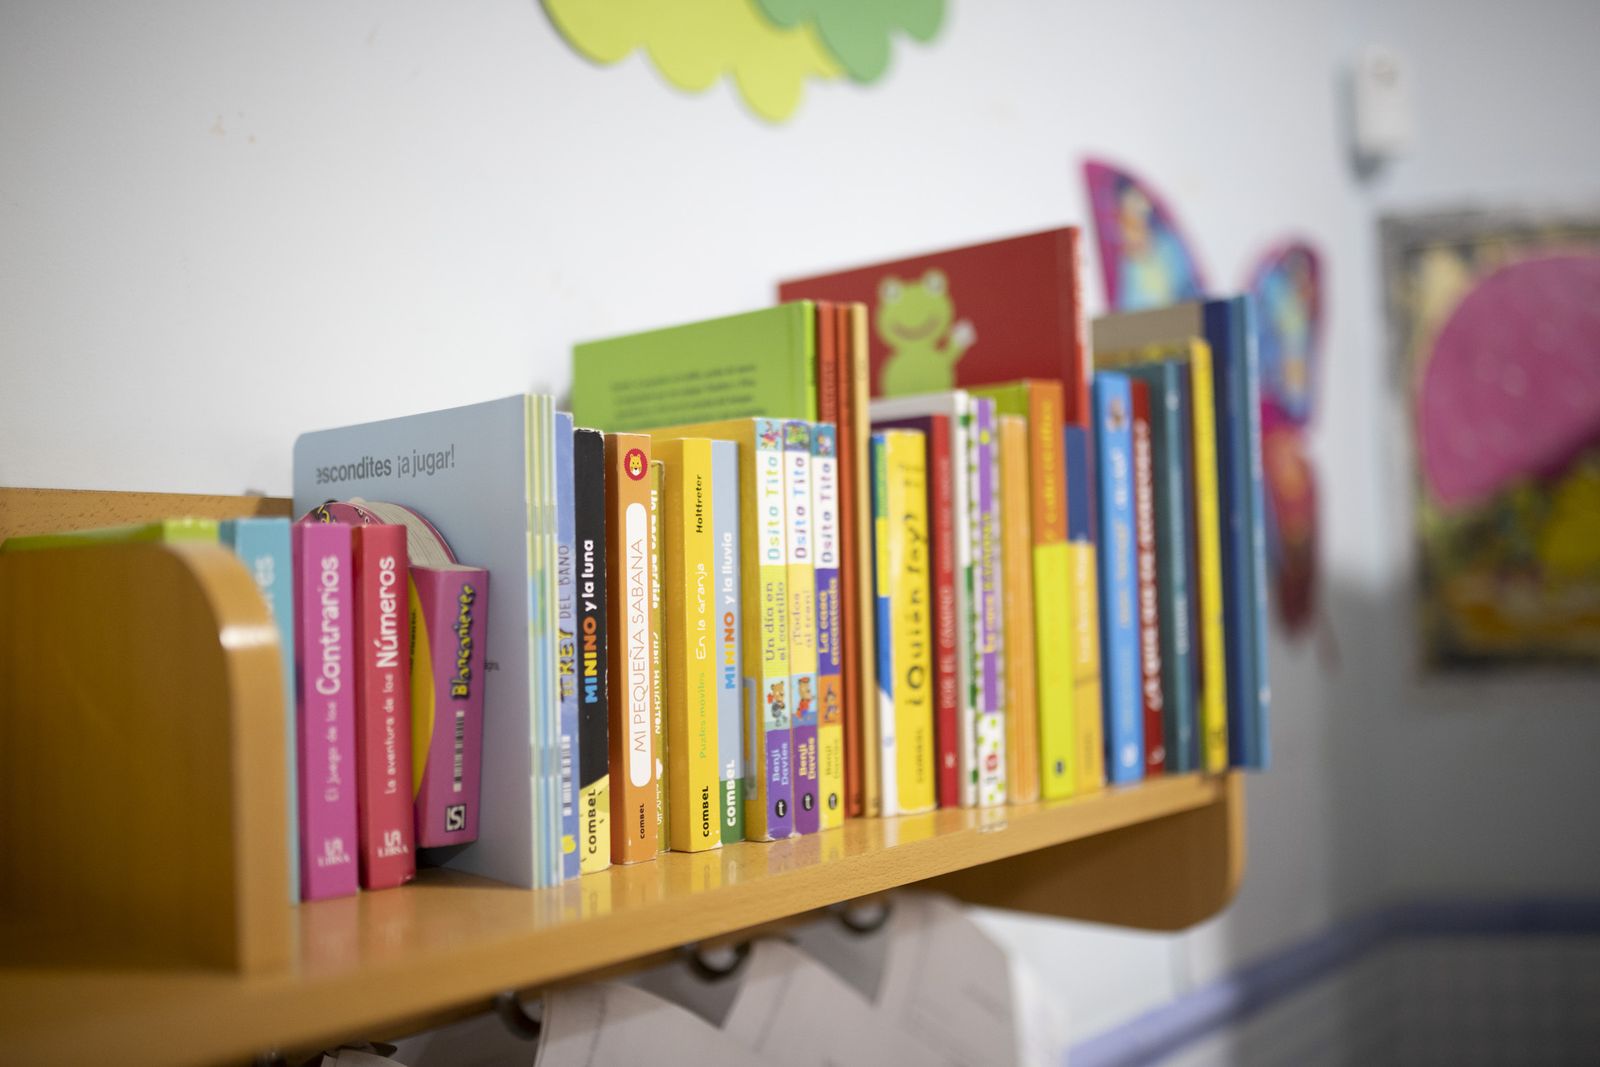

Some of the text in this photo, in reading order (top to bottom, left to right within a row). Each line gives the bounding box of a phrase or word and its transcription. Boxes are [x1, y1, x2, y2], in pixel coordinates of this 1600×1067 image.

[412, 444, 455, 477] jugar!
[766, 457, 780, 560] Osito Tito
[794, 457, 806, 559] Osito Tito
[820, 463, 833, 563] Osito Tito
[559, 595, 571, 619] DEL
[581, 540, 598, 703] MININO y la luna
[721, 532, 736, 689] MININO y la lluvia
[767, 582, 773, 602] en
[776, 582, 785, 661] el castillo
[315, 555, 341, 695] Contrarios
[451, 584, 475, 698] Blancanieves
[559, 628, 575, 675] REY
[629, 539, 648, 752] MI PEQUEÑA SABANA
[695, 635, 707, 660] En
[696, 619, 705, 631] la
[766, 638, 775, 661] Un
[904, 590, 925, 705] ¿Quién
[374, 556, 398, 794] La aventura de los Números
[771, 749, 781, 782] Benji
[781, 743, 789, 785] Davies
[798, 743, 808, 776] Benji
[808, 737, 816, 780] Davies
